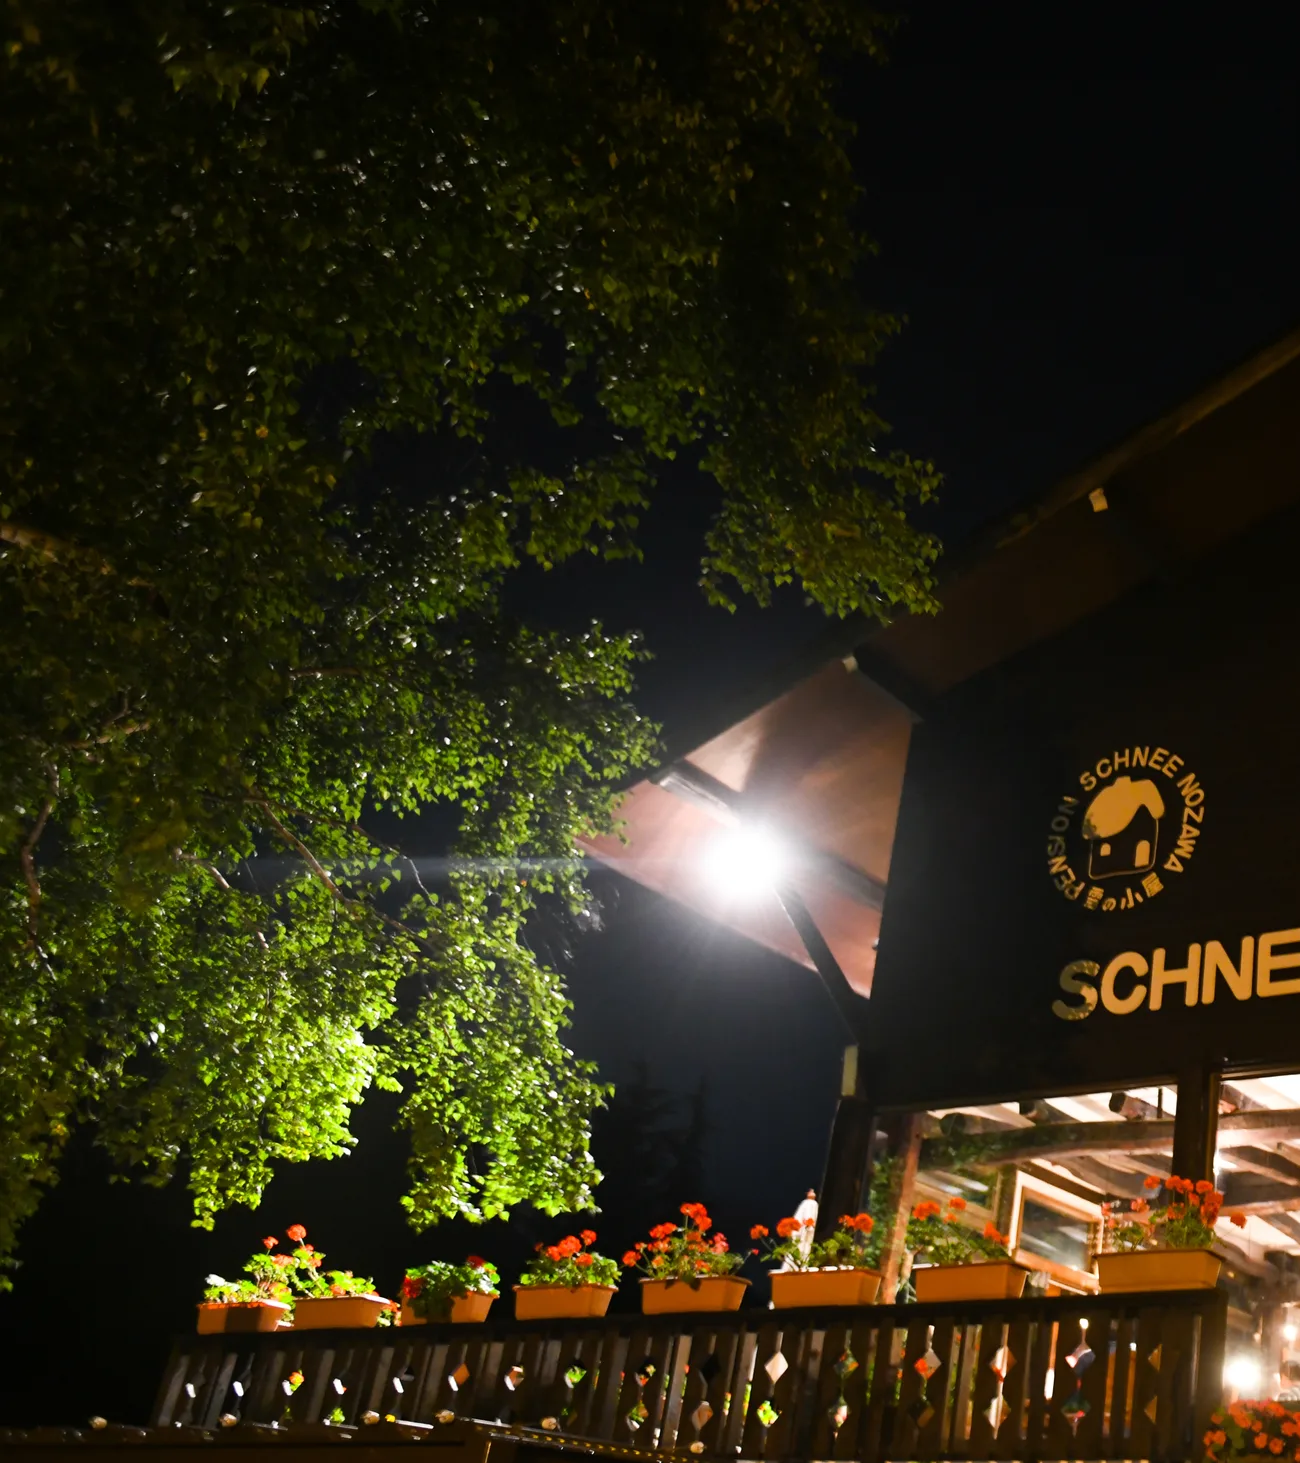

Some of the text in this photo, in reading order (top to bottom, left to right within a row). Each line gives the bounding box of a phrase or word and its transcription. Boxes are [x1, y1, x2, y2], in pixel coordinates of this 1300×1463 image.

[1047, 746, 1205, 900] PENSION SCHNEE NOZAWA
